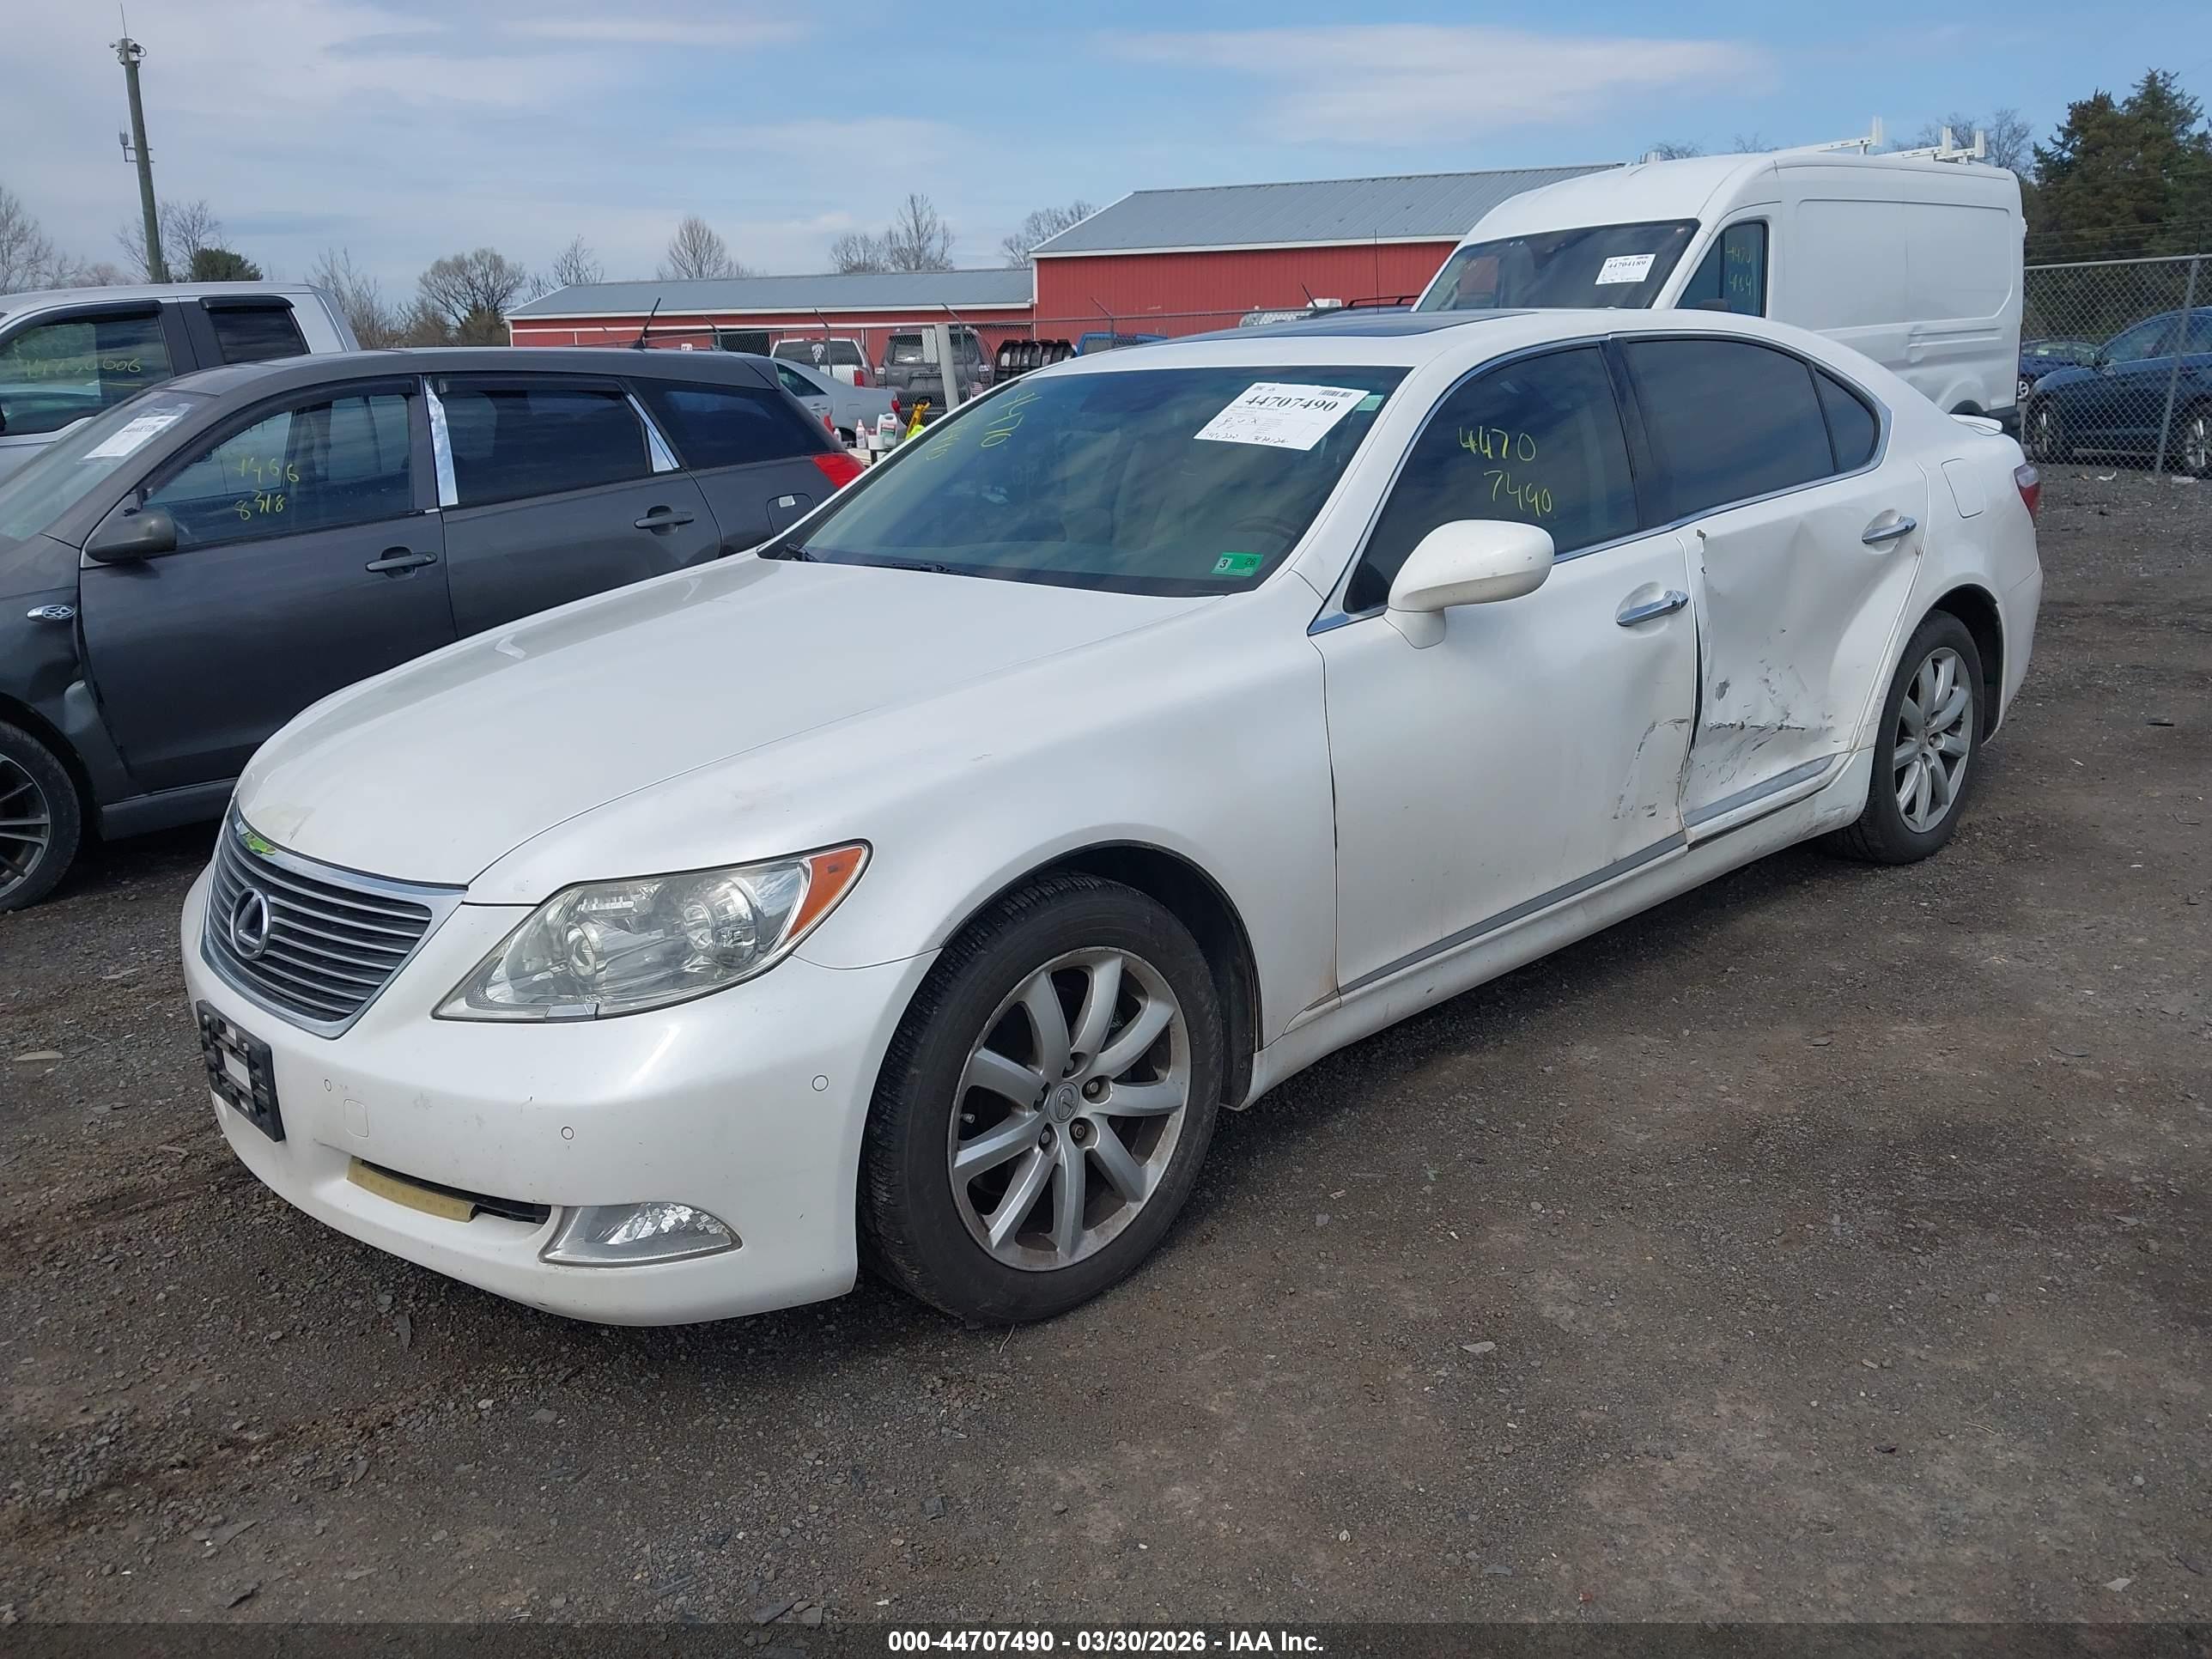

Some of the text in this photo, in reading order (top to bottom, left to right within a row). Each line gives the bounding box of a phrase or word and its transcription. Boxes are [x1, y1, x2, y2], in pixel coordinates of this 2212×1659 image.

[1245, 394, 1339, 412] 44707490
[1459, 425, 1537, 462] 4470
[1483, 470, 1553, 518] 7490
[1219, 557, 1257, 568] 3 26
